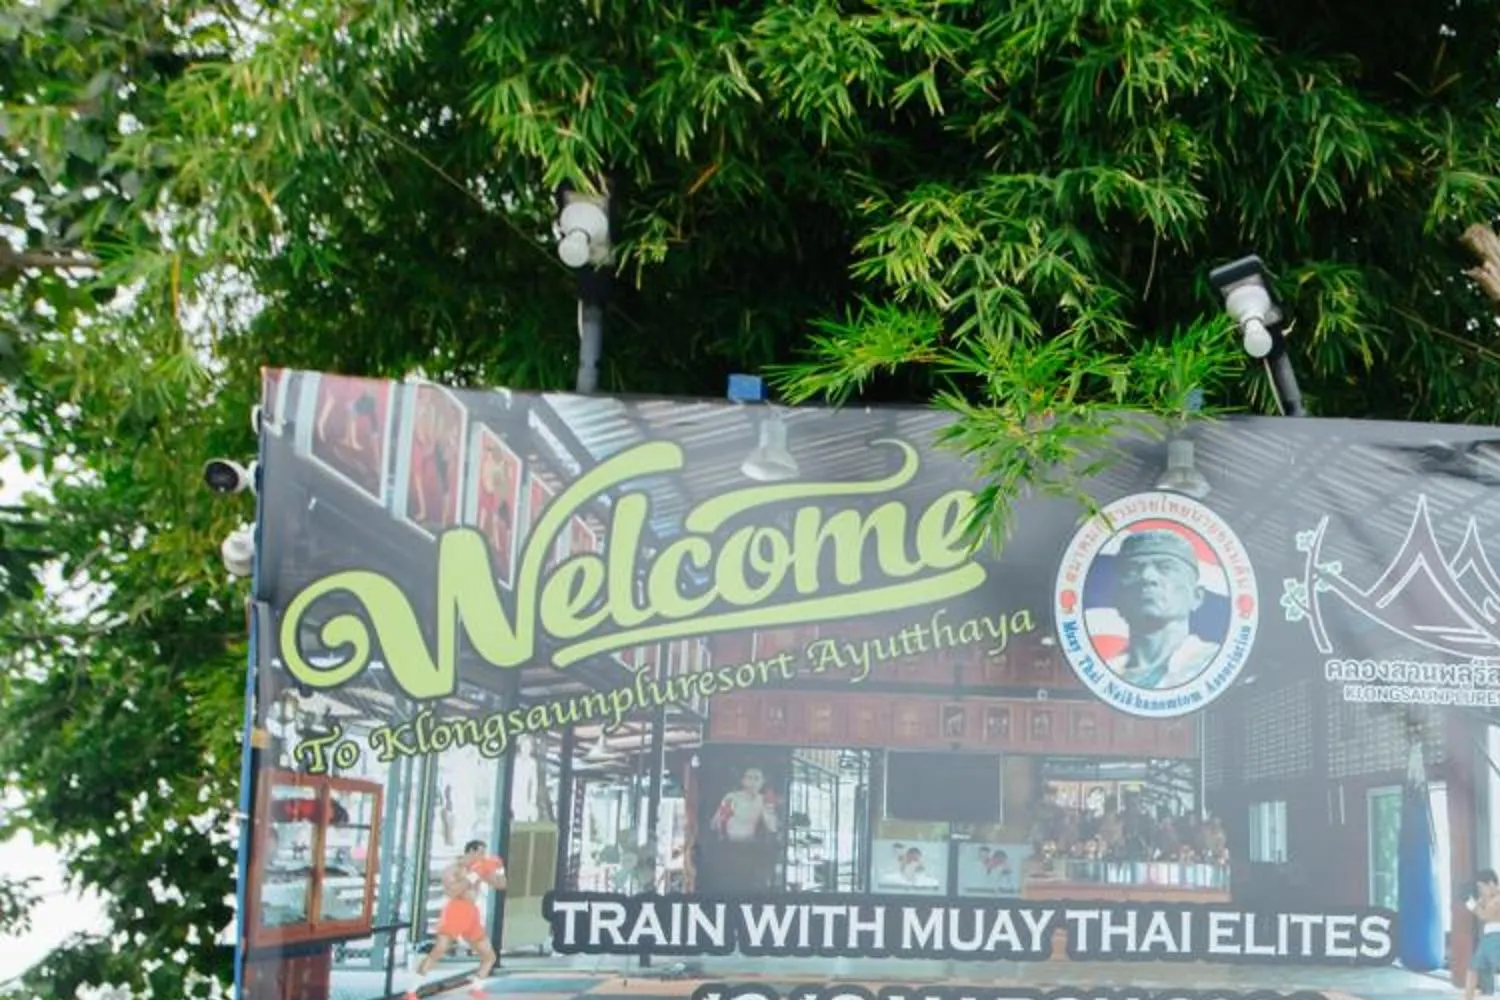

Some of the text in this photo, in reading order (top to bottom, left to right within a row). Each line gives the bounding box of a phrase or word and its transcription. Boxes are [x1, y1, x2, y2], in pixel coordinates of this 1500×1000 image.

[280, 438, 988, 699] Welcome
[294, 606, 1035, 773] To Klongsaunpluresort Ayutthaya
[1061, 619, 1082, 654] Muay
[1078, 654, 1103, 686] Thai
[552, 899, 1393, 960] TRAIN WITH MUAY THAI ELITES
